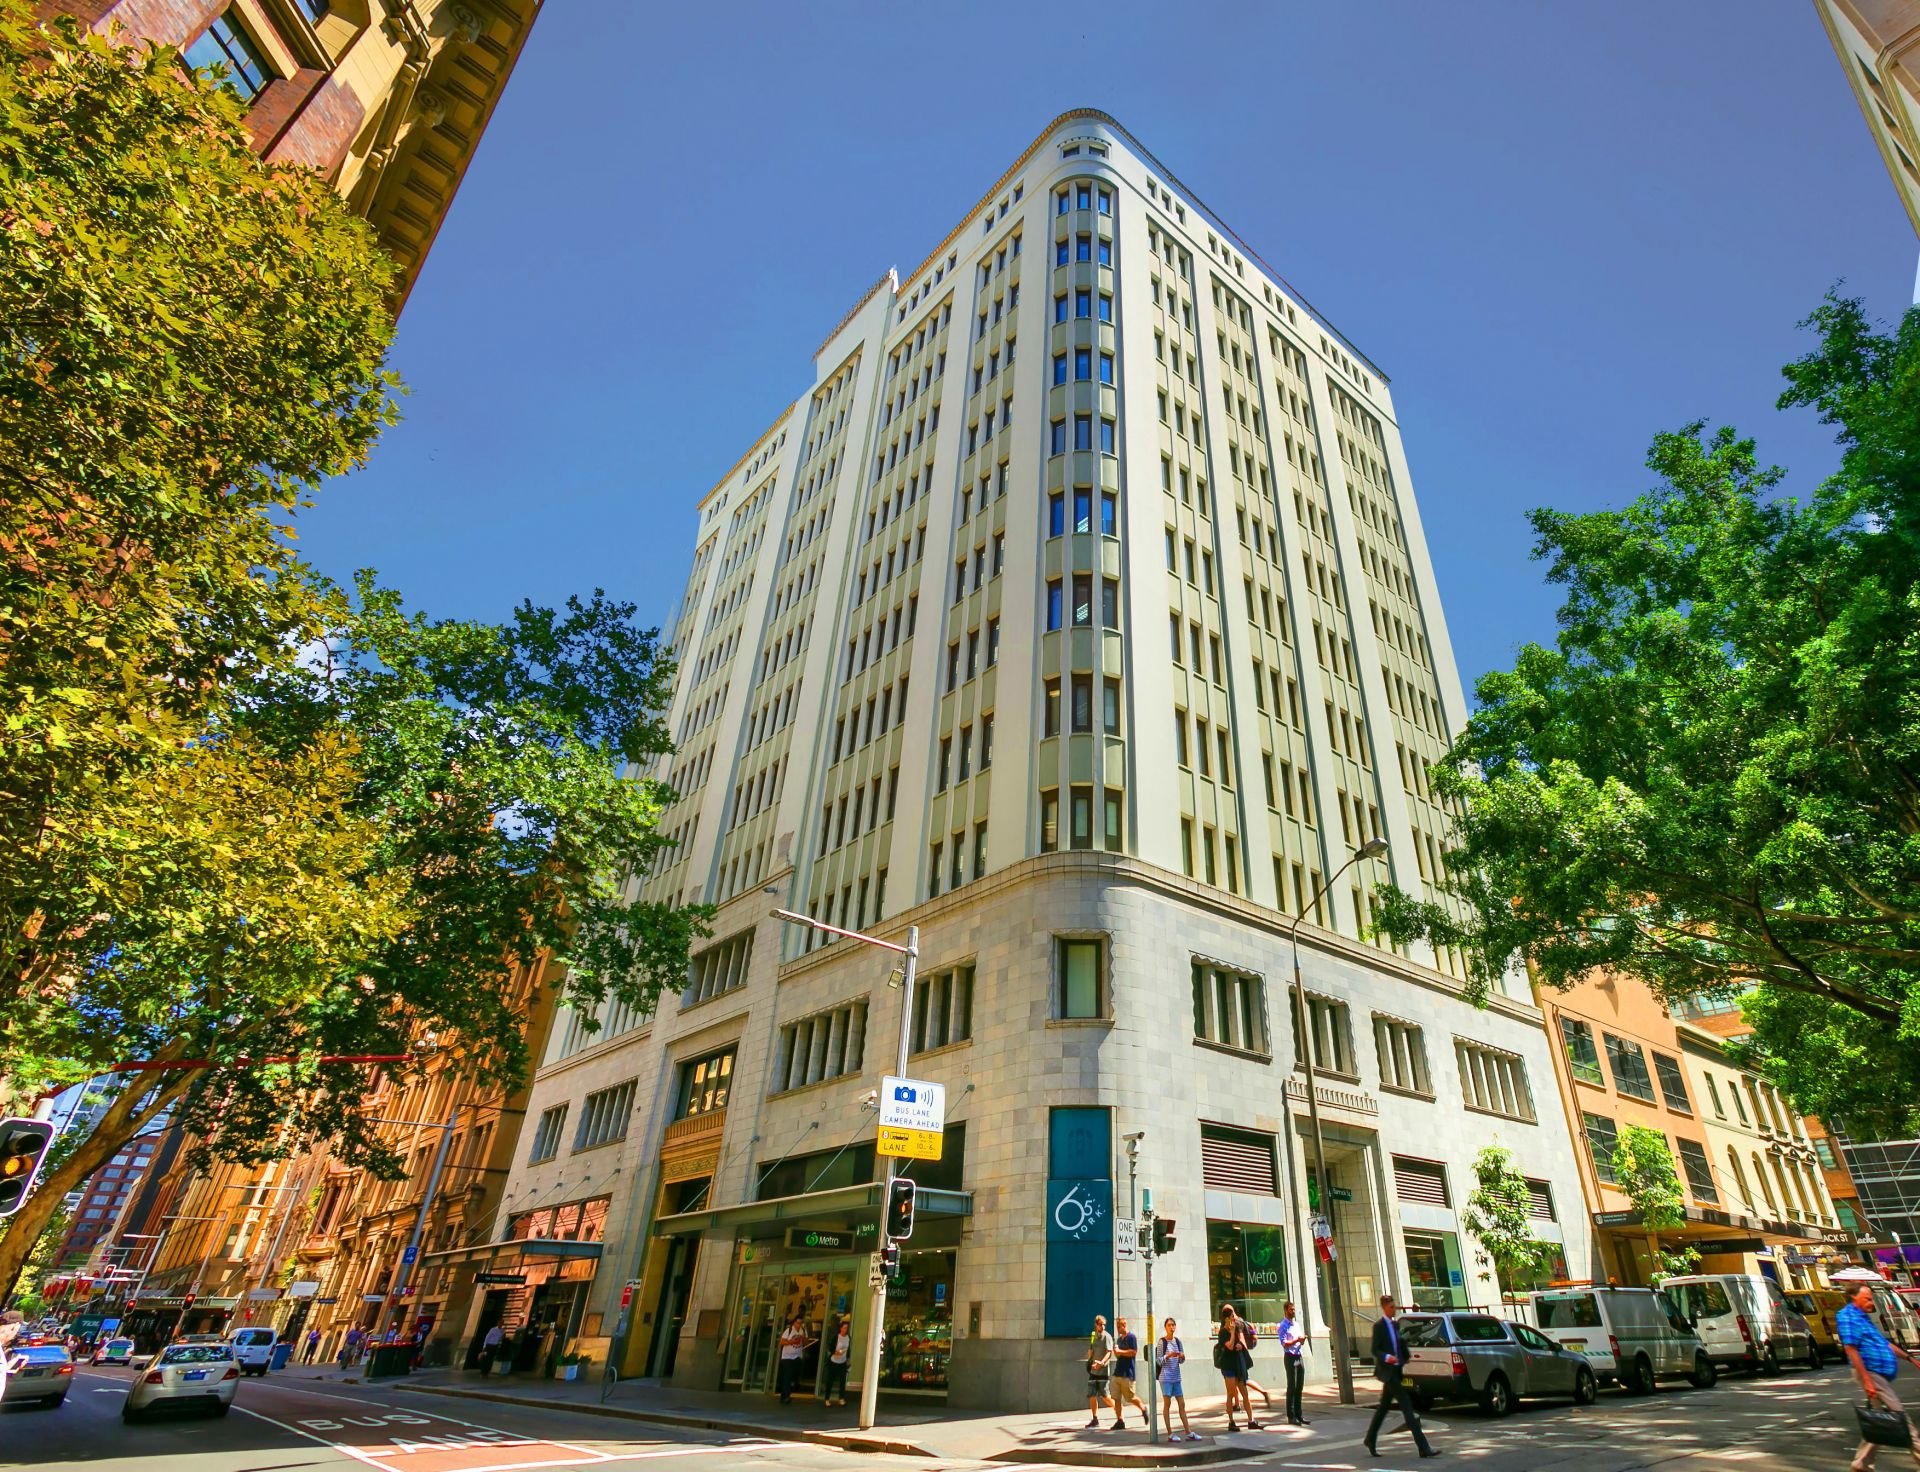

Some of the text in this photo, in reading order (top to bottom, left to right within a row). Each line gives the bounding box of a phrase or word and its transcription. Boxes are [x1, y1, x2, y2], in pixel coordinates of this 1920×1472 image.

[895, 1107, 930, 1117] BUS LANE
[884, 1116, 940, 1129] CAMERA AHEAD
[883, 1143, 906, 1152] LANE
[1073, 1209, 1103, 1240] YORK
[1118, 1221, 1133, 1233] ONE
[818, 1236, 839, 1247] Metro
[1117, 1234, 1134, 1245] WAY
[1839, 1233, 1848, 1242] ST
[1247, 1271, 1278, 1285] Metro
[887, 1289, 907, 1297] Metro
[297, 1414, 432, 1431] BUS
[336, 1431, 541, 1458] LANE
